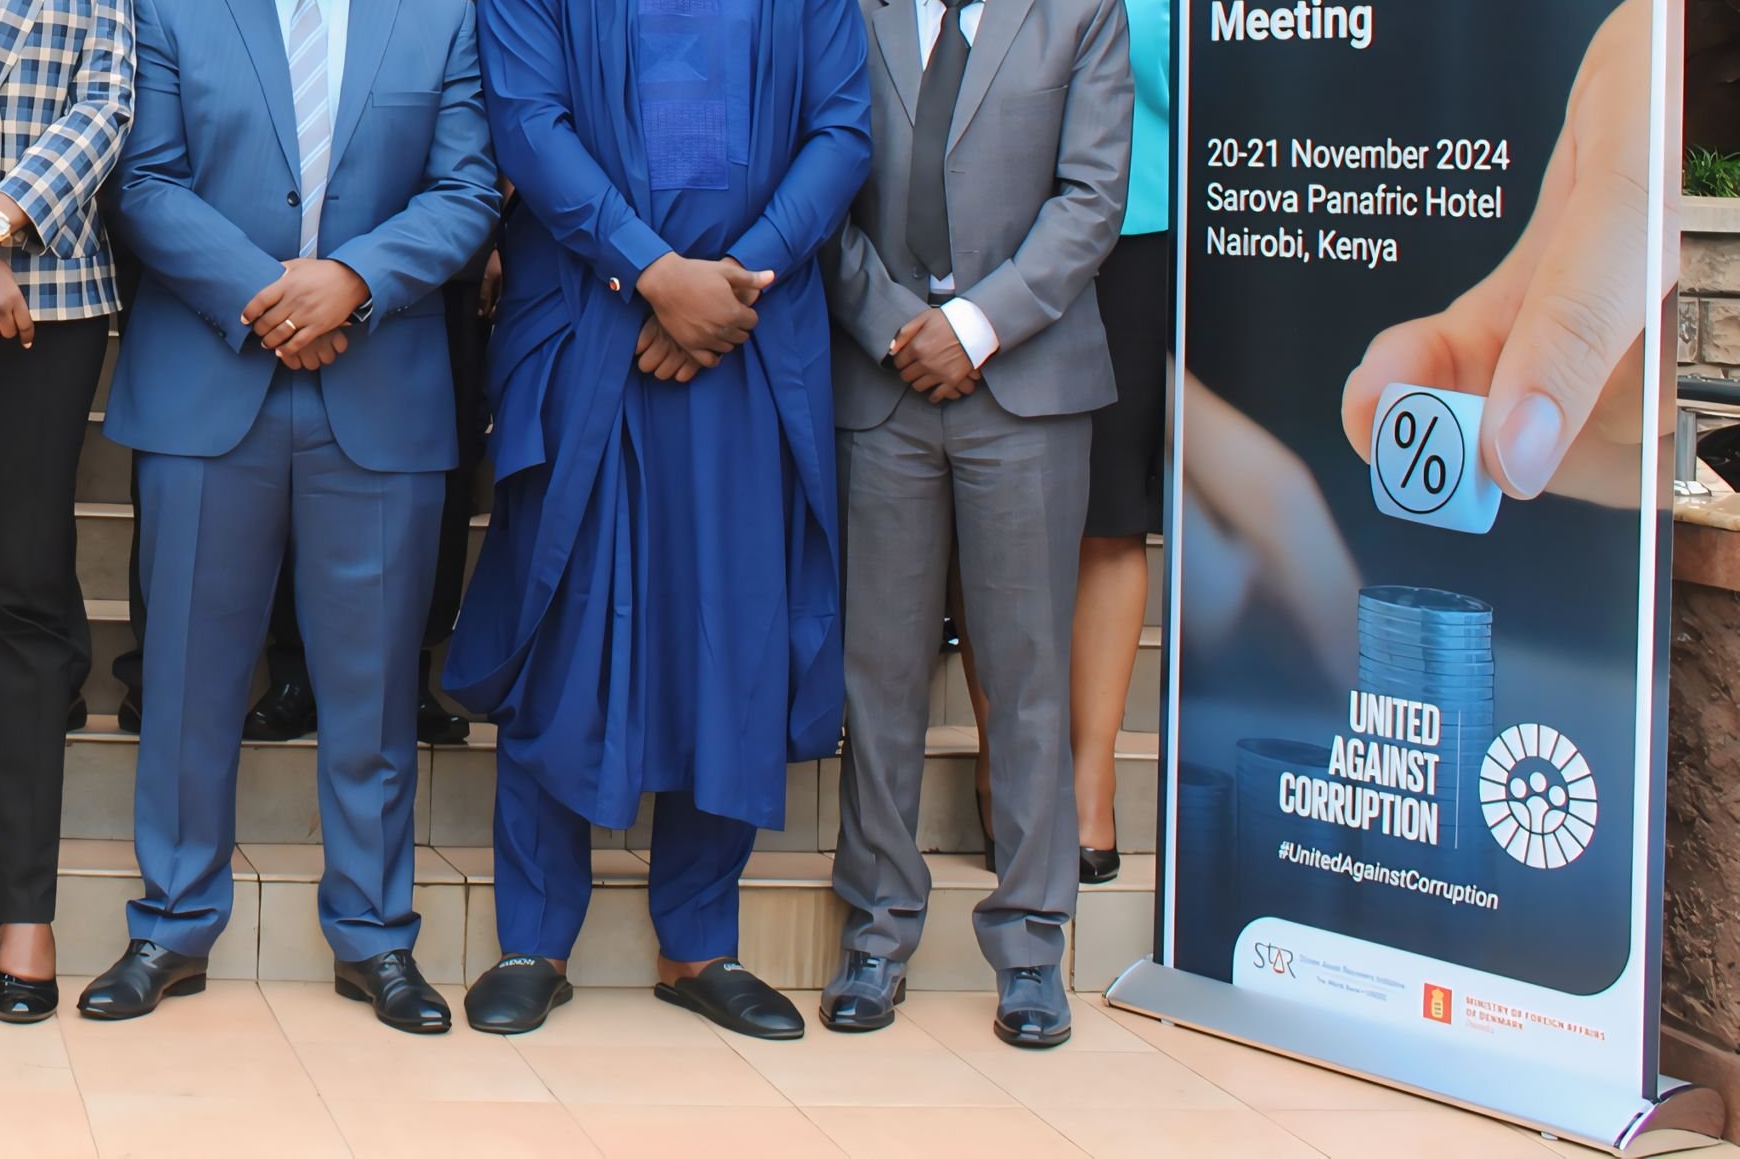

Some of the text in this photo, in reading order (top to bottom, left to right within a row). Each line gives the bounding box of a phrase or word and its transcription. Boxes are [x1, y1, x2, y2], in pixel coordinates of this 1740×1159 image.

[1207, 138, 1511, 171] 20-21 November 2024
[1206, 182, 1503, 218] Sarova Panafric Hotel
[1207, 226, 1398, 270] Nairobi, Kenya
[1394, 410, 1447, 495] %
[1349, 690, 1441, 747] UNITED
[1328, 734, 1440, 796] AGAINST
[1279, 771, 1439, 846] CORRUPTION
[1278, 840, 1499, 910] #UnitedAgainstCorruption
